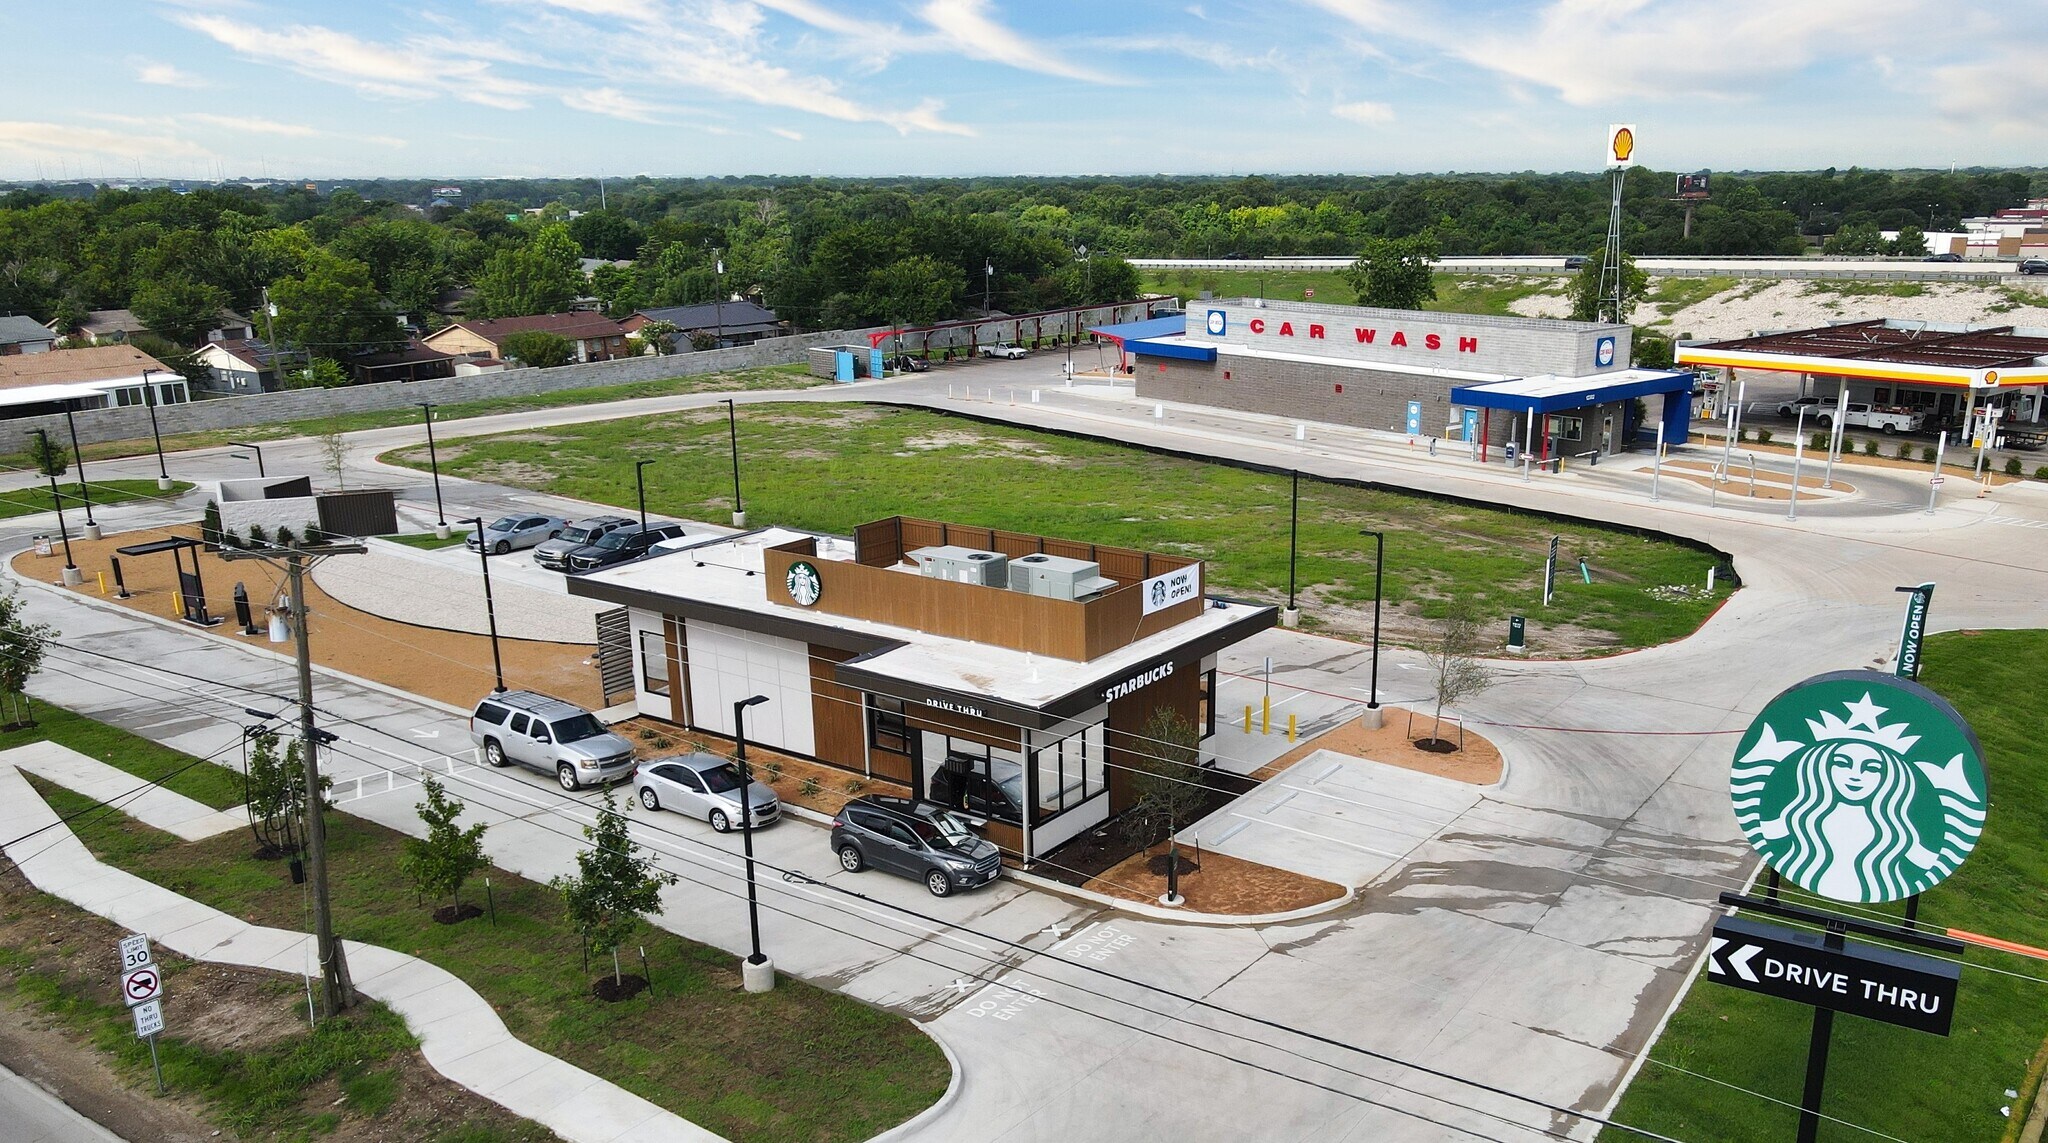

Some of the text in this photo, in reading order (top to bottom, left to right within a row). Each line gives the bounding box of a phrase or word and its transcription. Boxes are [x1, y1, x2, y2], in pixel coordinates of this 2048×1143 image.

[1250, 318, 1477, 353] CAR WASH
[1170, 574, 1188, 587] NOW
[1170, 584, 1192, 598] OPEN!
[1902, 605, 1924, 672] NOW OPEN
[1105, 661, 1174, 703] STARBUCKS
[926, 698, 983, 717] DRIVE THRU
[123, 938, 145, 949] SPEED
[126, 945, 144, 954] LIMIT
[1064, 925, 1122, 958] DO NOT
[1088, 934, 1138, 962] ENTER
[126, 950, 148, 967] 30
[1764, 958, 1940, 1014] DRIVE THRU
[966, 978, 1032, 1018] DO NOT
[992, 988, 1049, 1021] ENTER
[140, 1012, 158, 1024] THRU
[142, 1005, 153, 1014] NO
[140, 1021, 162, 1033] TRUCKS
